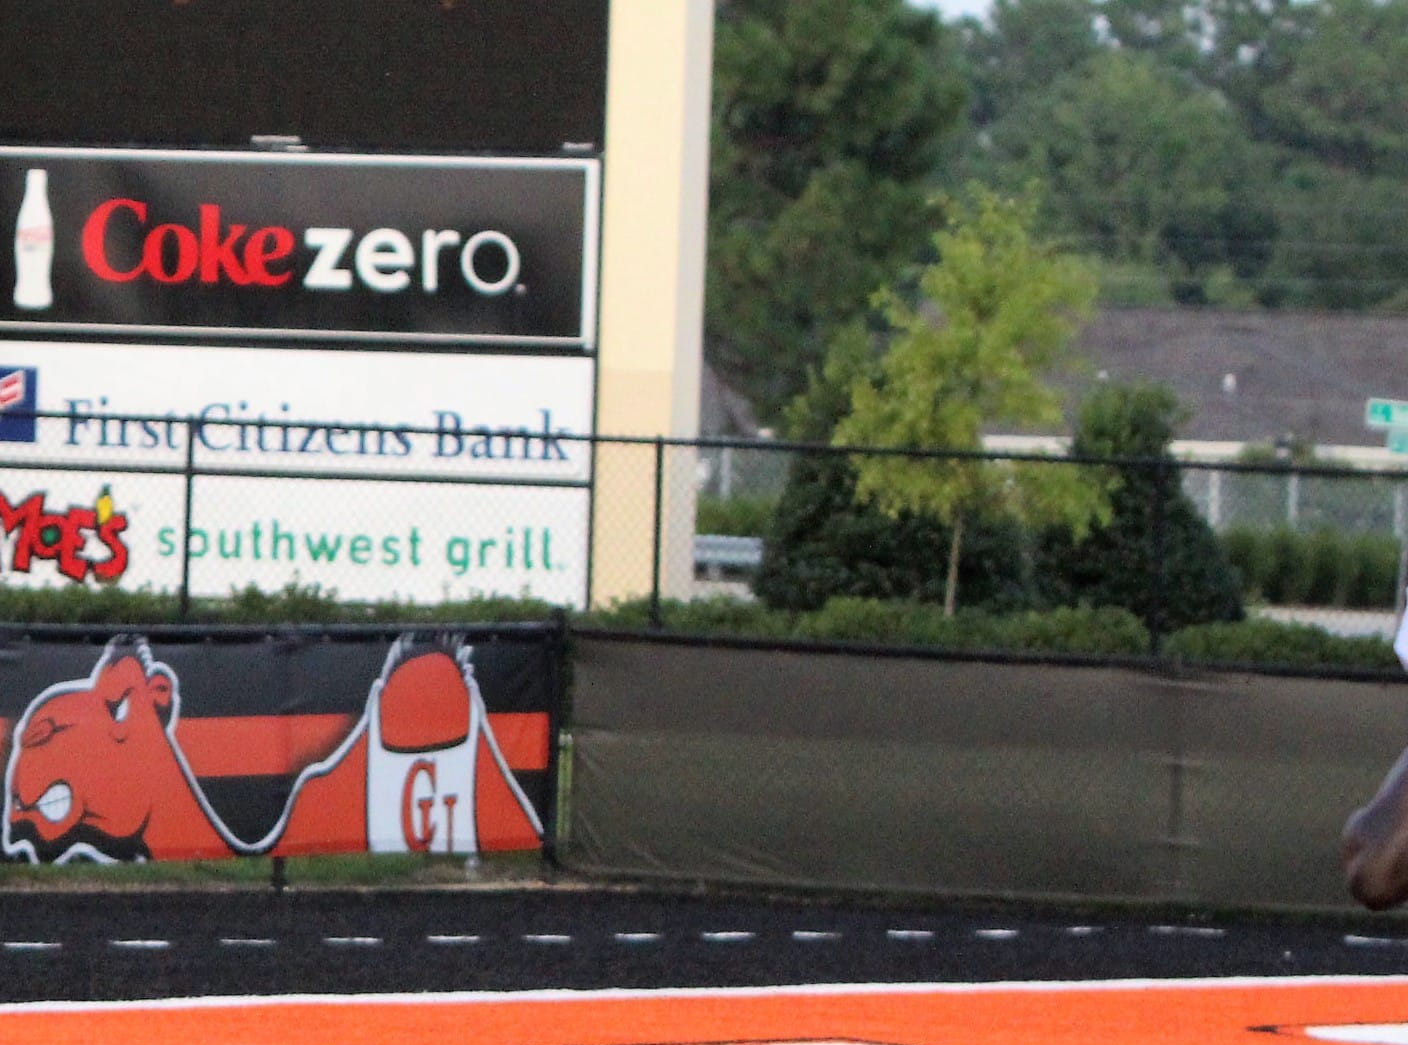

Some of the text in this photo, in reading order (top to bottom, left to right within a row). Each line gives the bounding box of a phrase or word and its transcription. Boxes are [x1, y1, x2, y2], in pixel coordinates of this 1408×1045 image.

[81, 198, 521, 295] Coke zero
[64, 396, 570, 462] First Citizens Bank
[157, 518, 553, 576] southwest grill
